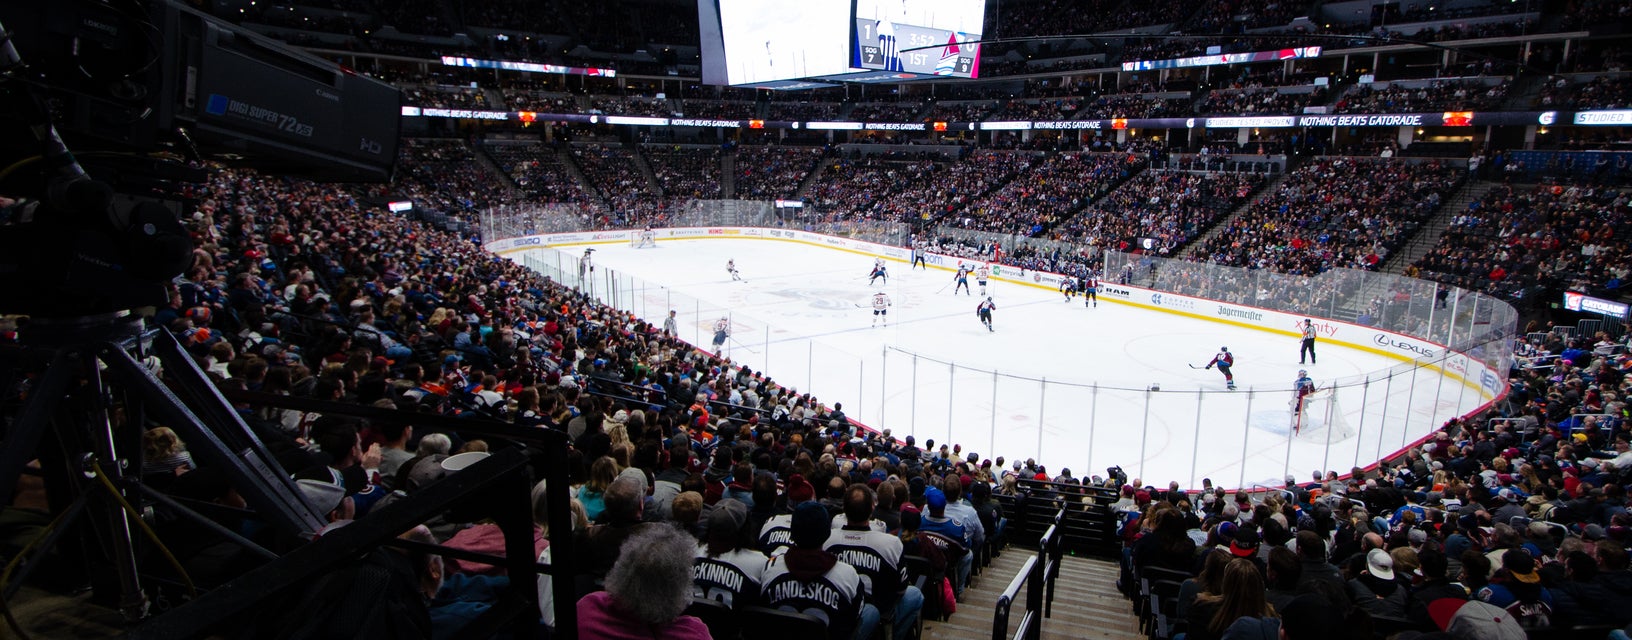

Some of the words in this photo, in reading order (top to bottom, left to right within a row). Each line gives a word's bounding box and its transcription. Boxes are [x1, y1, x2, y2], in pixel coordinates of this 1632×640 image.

[864, 24, 871, 40] 1
[910, 33, 935, 47] 3:52
[868, 54, 874, 63] 7
[909, 53, 928, 66] 1ST
[962, 63, 968, 72] 9
[228, 99, 249, 115] DIGI
[249, 105, 279, 123] SUPER
[423, 108, 450, 118] NOTHING
[450, 110, 472, 118] BEATS
[1578, 113, 1624, 122] STUDIED
[1055, 121, 1072, 129] BEATS
[1299, 117, 1336, 126] NOTHING
[1337, 116, 1367, 126] BEATS
[1105, 287, 1130, 296] RAM
[1295, 320, 1338, 337] xnity
[1391, 339, 1433, 358] LEXUS
[834, 549, 881, 572] cKINNON
[693, 561, 743, 593] cKINNON
[768, 582, 840, 610] LANDESKOG
